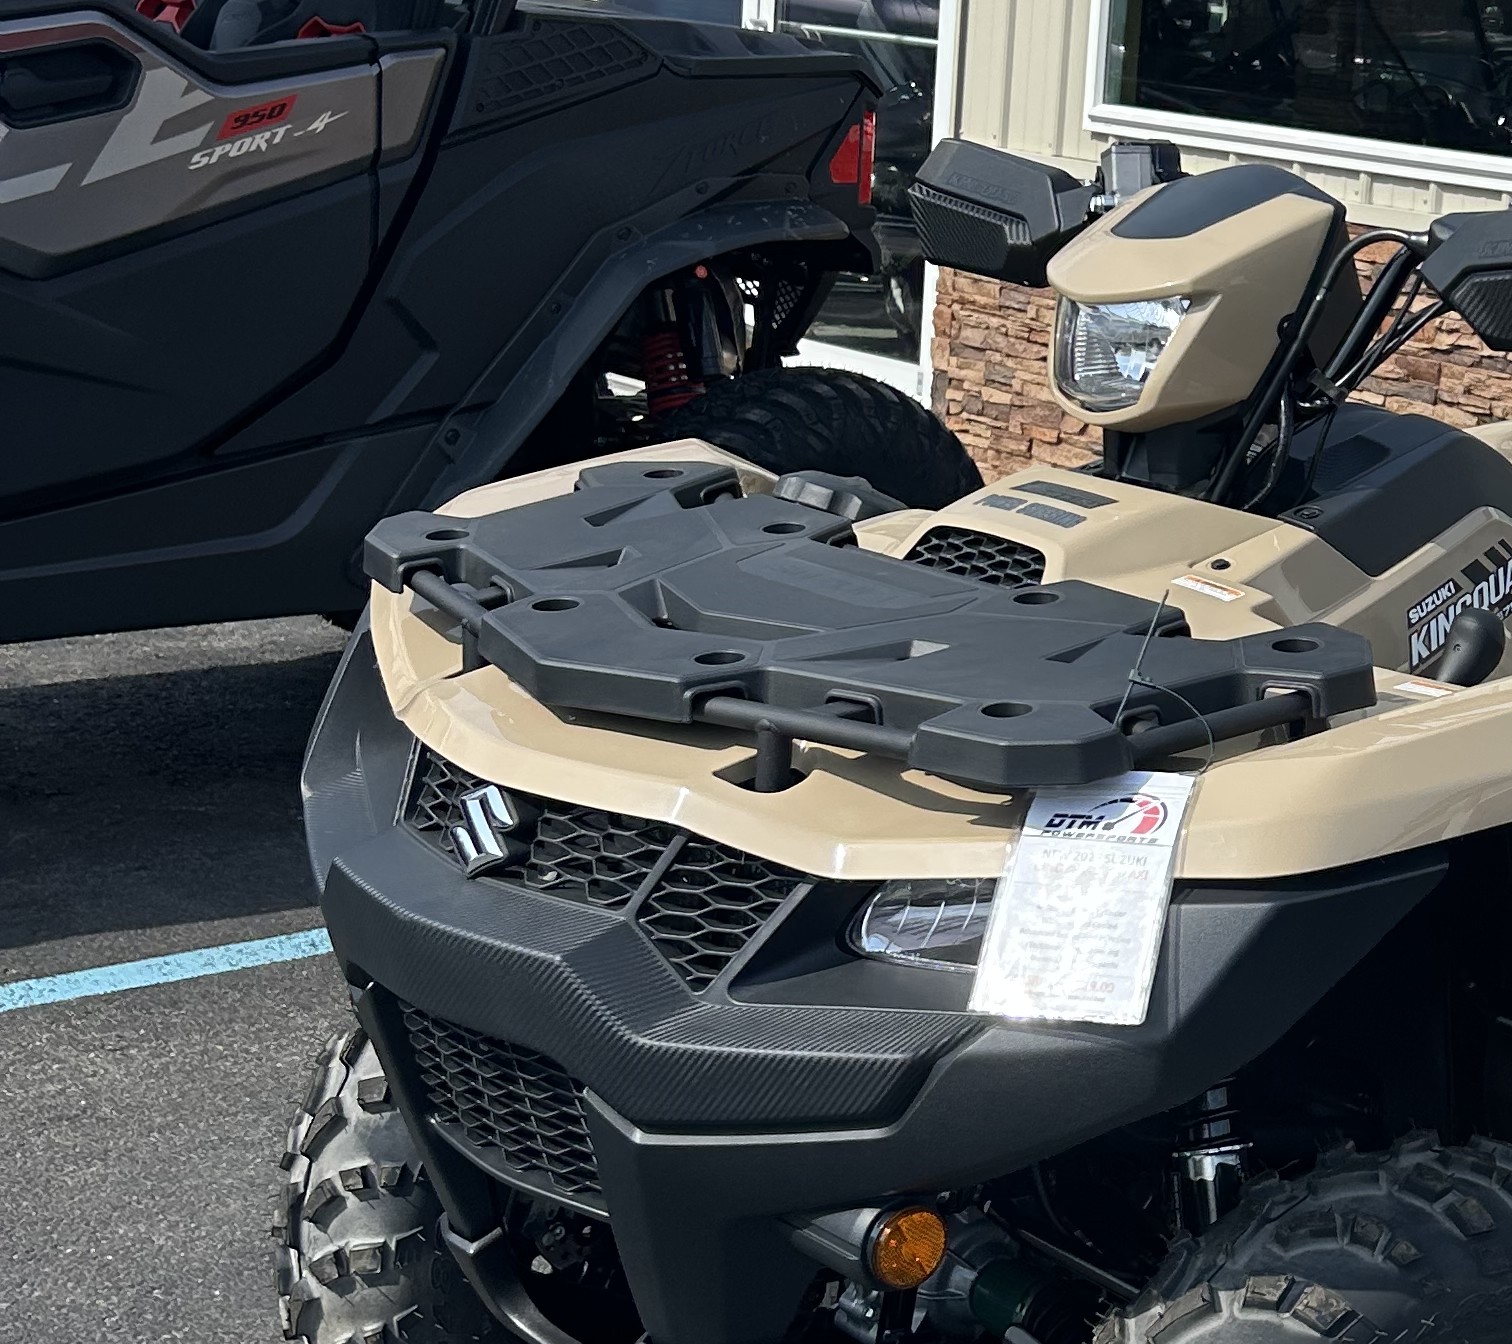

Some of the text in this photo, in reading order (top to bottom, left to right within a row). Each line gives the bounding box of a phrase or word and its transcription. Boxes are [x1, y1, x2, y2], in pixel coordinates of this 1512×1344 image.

[230, 102, 288, 131] 950
[1408, 580, 1456, 625] SUZUKI
[1044, 812, 1106, 831] DTM
[1040, 829, 1159, 844] POWERSPORTS
